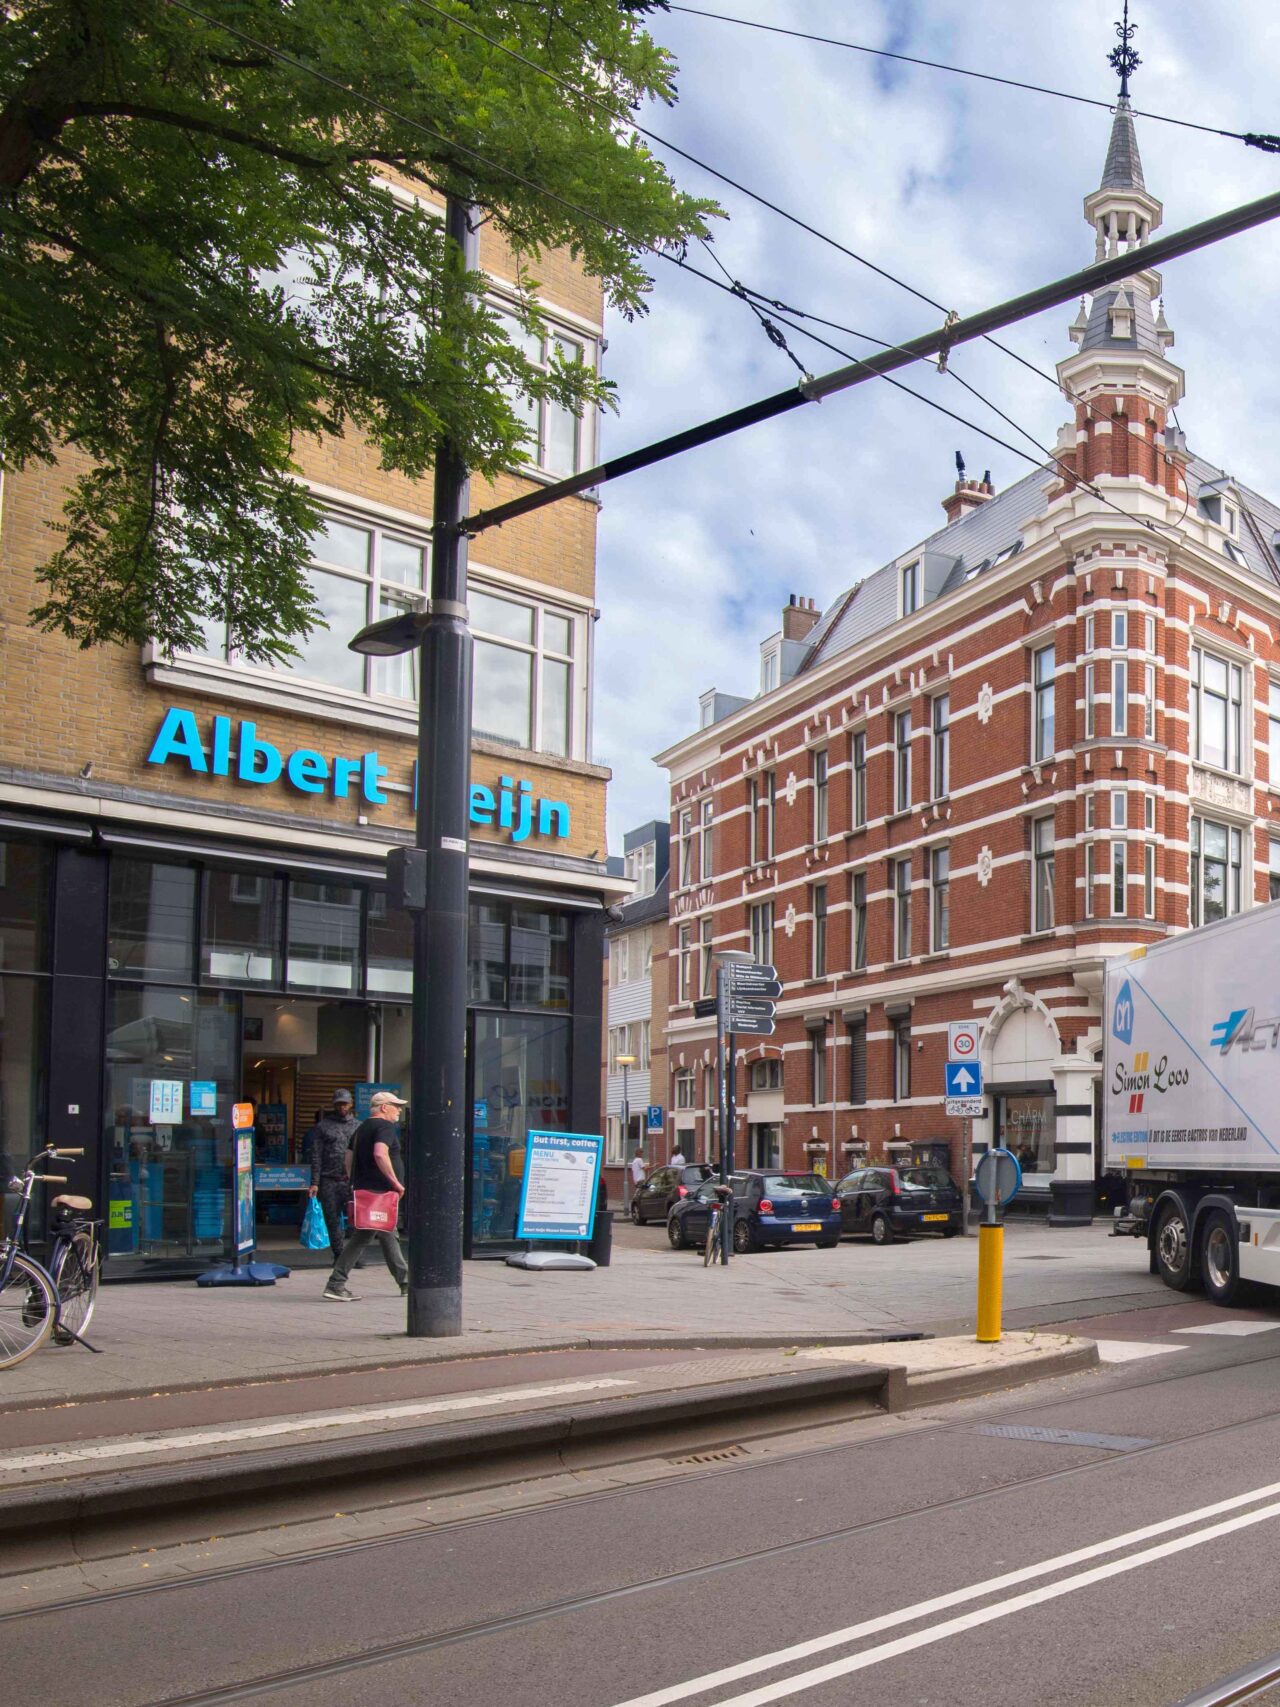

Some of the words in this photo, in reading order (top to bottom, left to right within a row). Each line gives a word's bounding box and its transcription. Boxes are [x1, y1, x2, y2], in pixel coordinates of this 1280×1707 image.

[147, 707, 388, 805] Albert
[413, 759, 570, 842] eijn
[958, 1040, 971, 1048] 30
[1112, 1062, 1150, 1095] Simon
[1153, 1055, 1189, 1093] Loos
[651, 1108, 660, 1118] P
[1010, 1107, 1048, 1125] CHARM
[533, 1135, 549, 1144] But
[549, 1137, 570, 1147] first,
[571, 1139, 599, 1148] coffee.
[1165, 1130, 1172, 1142] DE
[1172, 1129, 1187, 1142] EERSTE
[1219, 1127, 1248, 1141] NEDERLAND
